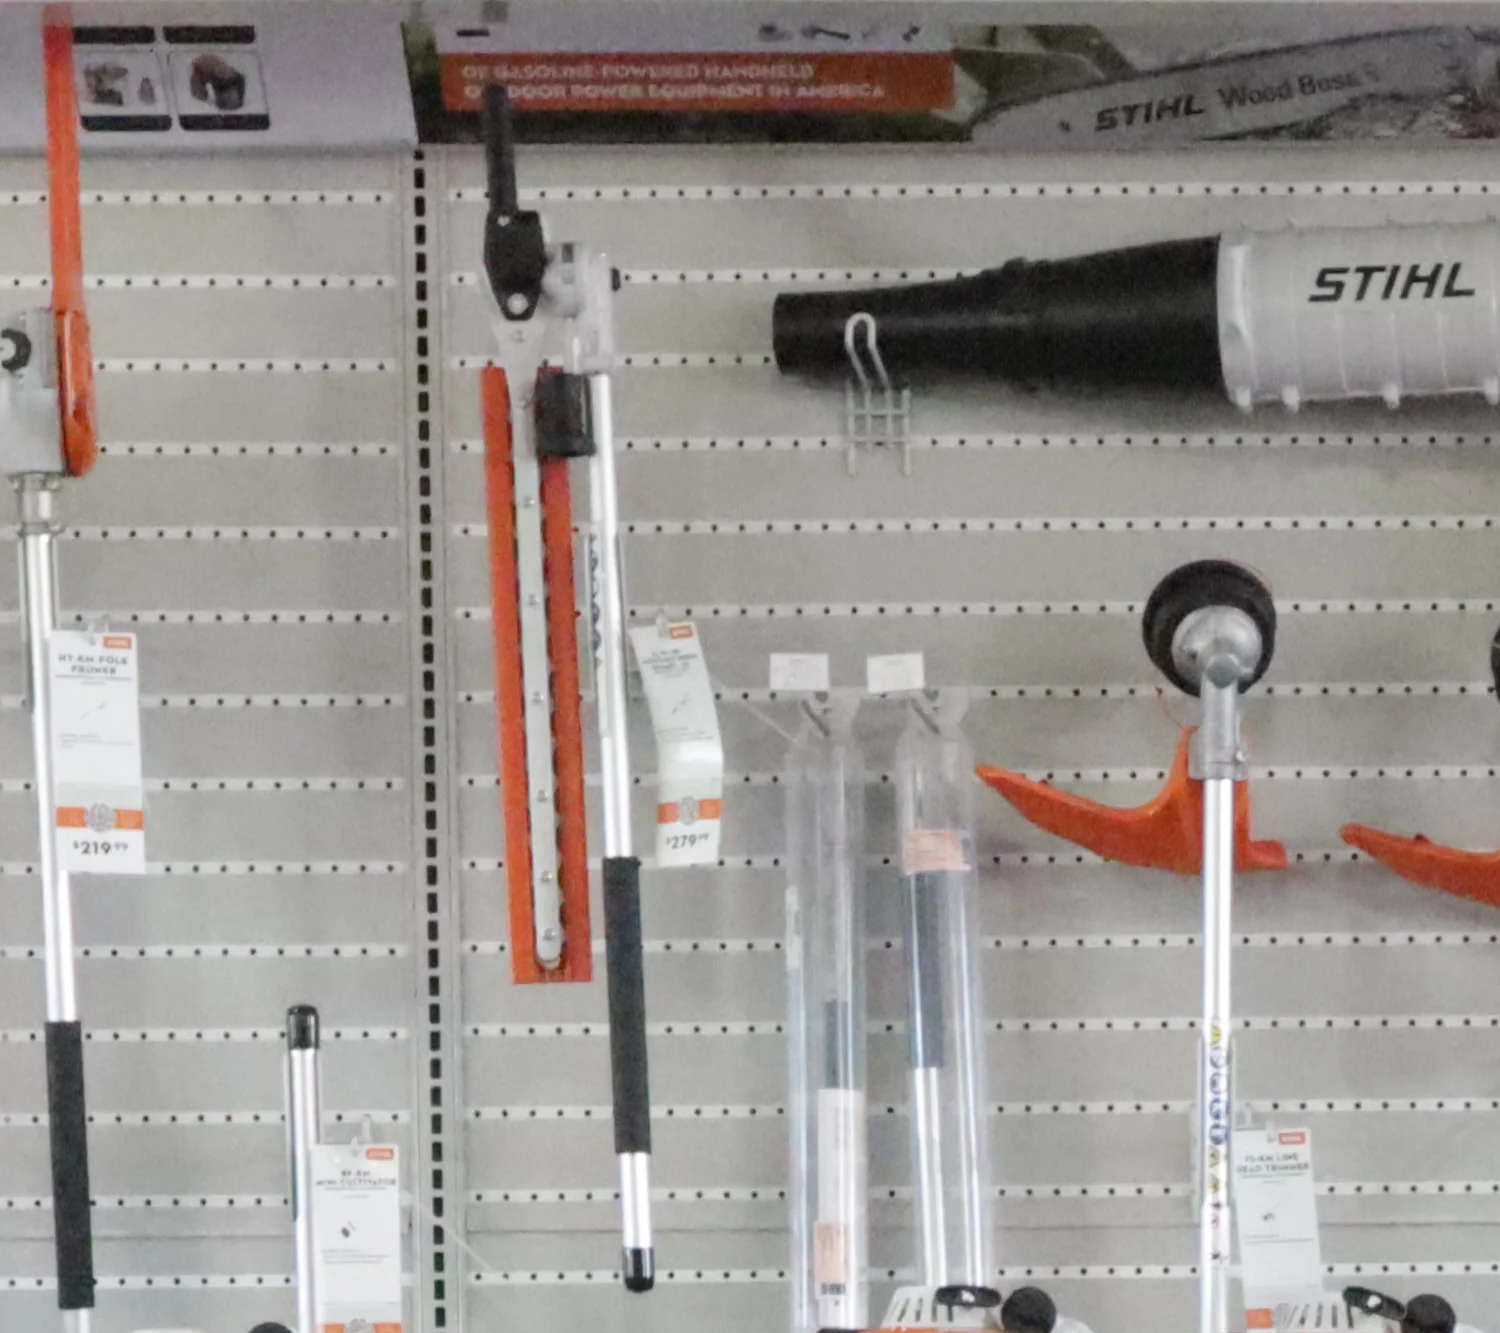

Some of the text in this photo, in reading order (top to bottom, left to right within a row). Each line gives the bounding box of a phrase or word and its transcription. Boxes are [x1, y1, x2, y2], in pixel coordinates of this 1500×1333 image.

[464, 84, 566, 98] ODOOR
[570, 84, 643, 98] POWER
[648, 84, 765, 98] EQUIPMENT
[796, 83, 886, 97] AMERICA
[1095, 94, 1205, 132] STIHL
[1216, 80, 1293, 110] Wood
[1308, 252, 1476, 302] STIHL
